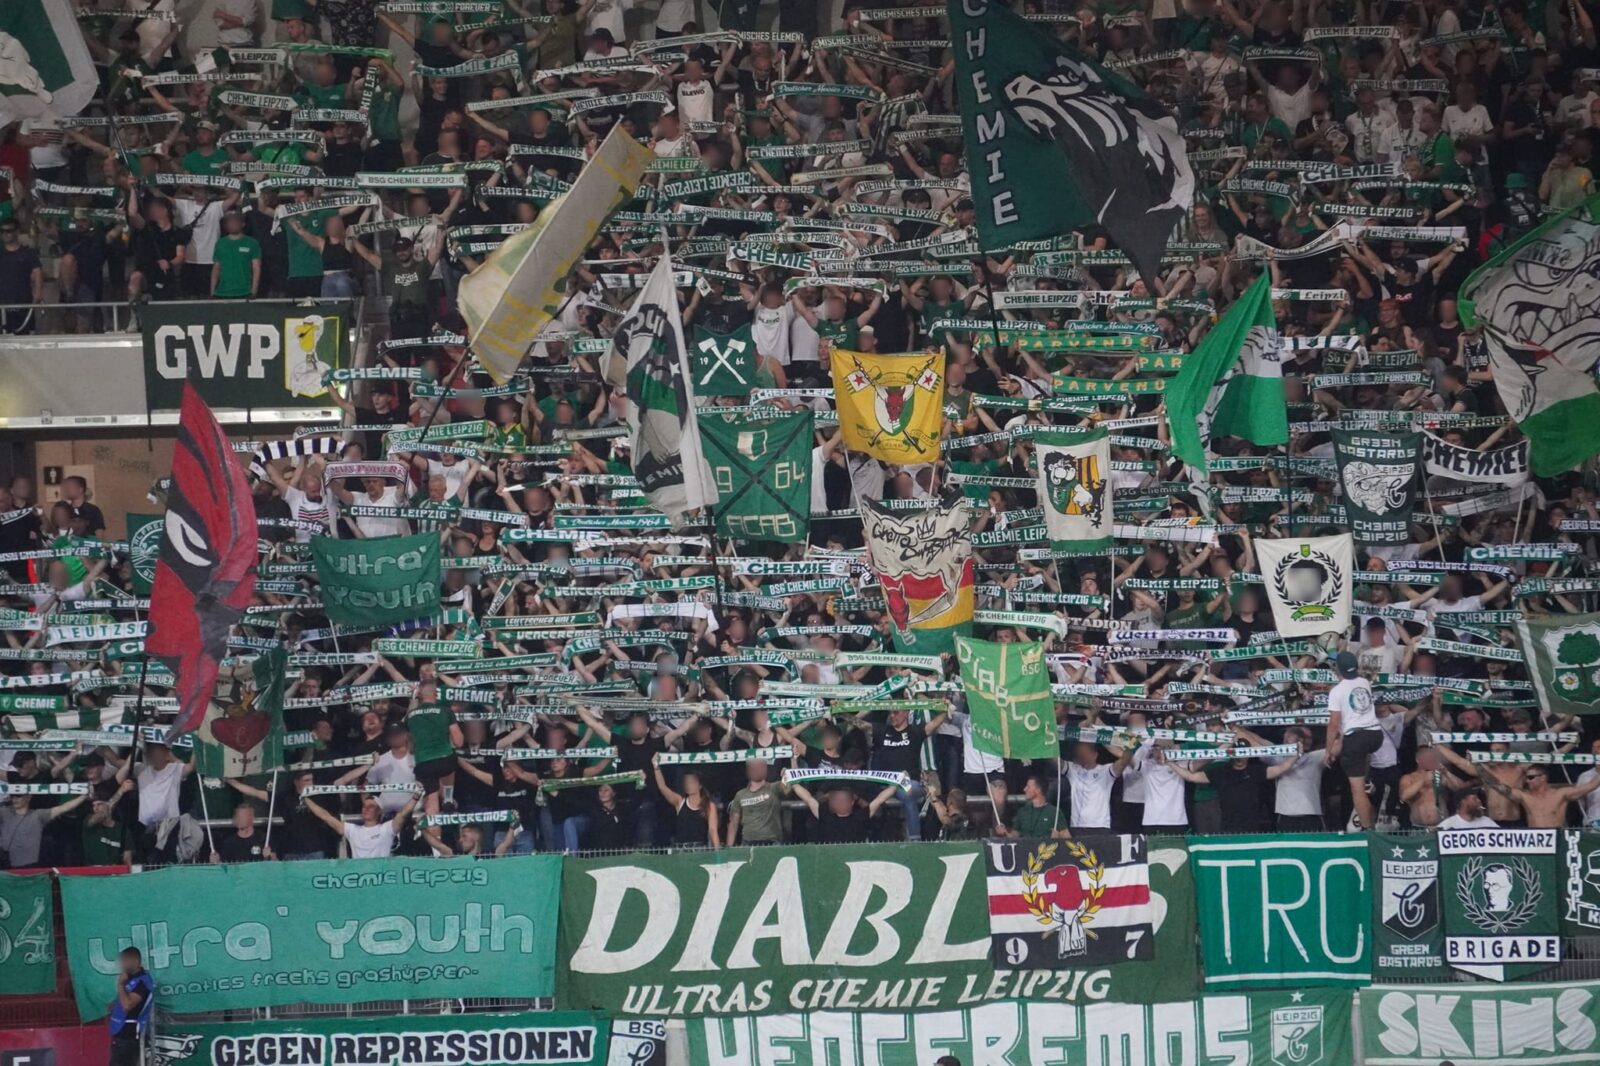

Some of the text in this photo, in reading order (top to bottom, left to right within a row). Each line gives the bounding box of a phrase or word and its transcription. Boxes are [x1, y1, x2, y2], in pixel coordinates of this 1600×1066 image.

[1313, 27, 1390, 36] CHEMIE LEIPZIG
[226, 93, 289, 109] CHEMIE LEIPZIG
[962, 0, 1019, 227] CHEMIE
[229, 131, 275, 140] CHEMIE
[1304, 163, 1395, 182] CHEMIE
[176, 174, 208, 185] CHEMIE
[368, 176, 454, 184] BSG CHEMIE LEIPZIG
[849, 203, 940, 220] BSG CHEMIE LEIPZIG
[1323, 204, 1413, 218] CHEMIE LEIPZIG
[733, 247, 813, 269] CHEMIE
[1004, 294, 1077, 304] CHEMIE LEIPZIG
[154, 323, 280, 379] GWP
[735, 356, 744, 365] 64
[333, 367, 422, 379] CHEMIE
[388, 423, 483, 443] BSG CHEMIE LEIPZIG
[416, 443, 446, 454] CHEMIE
[448, 445, 476, 457] LEIPZIG
[1338, 446, 1416, 459] BASTARDS
[775, 462, 806, 489] 64
[351, 506, 447, 520] CHEMIE LEIPZIG
[491, 511, 526, 525] LEIPZIG
[726, 514, 796, 537] ACAB
[1297, 515, 1333, 524] CHEMIE
[509, 529, 601, 540] CHEMIE
[981, 531, 1023, 543] CHEMIE
[1471, 548, 1563, 559] CHEMIE
[269, 564, 308, 573] CHEMIE
[747, 563, 832, 574] CHEMIE
[1125, 578, 1219, 589] CHEMIE LEIPZIG
[1391, 573, 1432, 584] LEIPZIG
[769, 581, 818, 594] BSG CHEMIE
[1025, 593, 1096, 604] CHEMIE LEIPZIG
[55, 614, 89, 625] LEIPZIG
[990, 613, 1046, 623] CHEMIE LEIPZIG
[1458, 613, 1498, 624] CHEMIE
[777, 624, 872, 637] BSG CHEMIE LEIPZIG
[377, 642, 474, 653] BSG CHEMIE LEIPZIG
[1224, 648, 1252, 658] SIND
[1430, 639, 1487, 655] BSG CHEMIE
[704, 653, 789, 666] BSG CHEMIE LEIPZIG
[866, 654, 899, 664] CHEMIE
[901, 655, 933, 665] LEIPZIG
[1021, 664, 1041, 676] BSG
[1406, 674, 1437, 685] CHEMIE
[1438, 677, 1470, 689] LEIPZIG
[445, 688, 494, 703] CHEMIE
[14, 697, 56, 709] CHEMIE
[1433, 732, 1578, 742] DIABLOS
[659, 746, 793, 764] DIABLOS
[1166, 749, 1227, 760] ULTRAS
[427, 810, 508, 825] VENCEREMOS
[1442, 831, 1553, 848] GEORG SCHWARZ
[1385, 864, 1436, 875] LEIPZIG
[1198, 858, 1364, 964] TRC
[1005, 930, 1145, 965] 9 7
[1390, 944, 1430, 955] GREEN
[1450, 939, 1556, 958] BRIGADE
[1378, 955, 1443, 967] BASTARDS
[622, 970, 1111, 1015] ULTRAS CHEMIE LEIPZIG
[1275, 1011, 1318, 1021] LEIPZIG
[1378, 988, 1597, 1057] SKINS
[629, 1021, 666, 1037] BSG
[213, 1028, 594, 1066] GEGEN REPRESSIONEN
